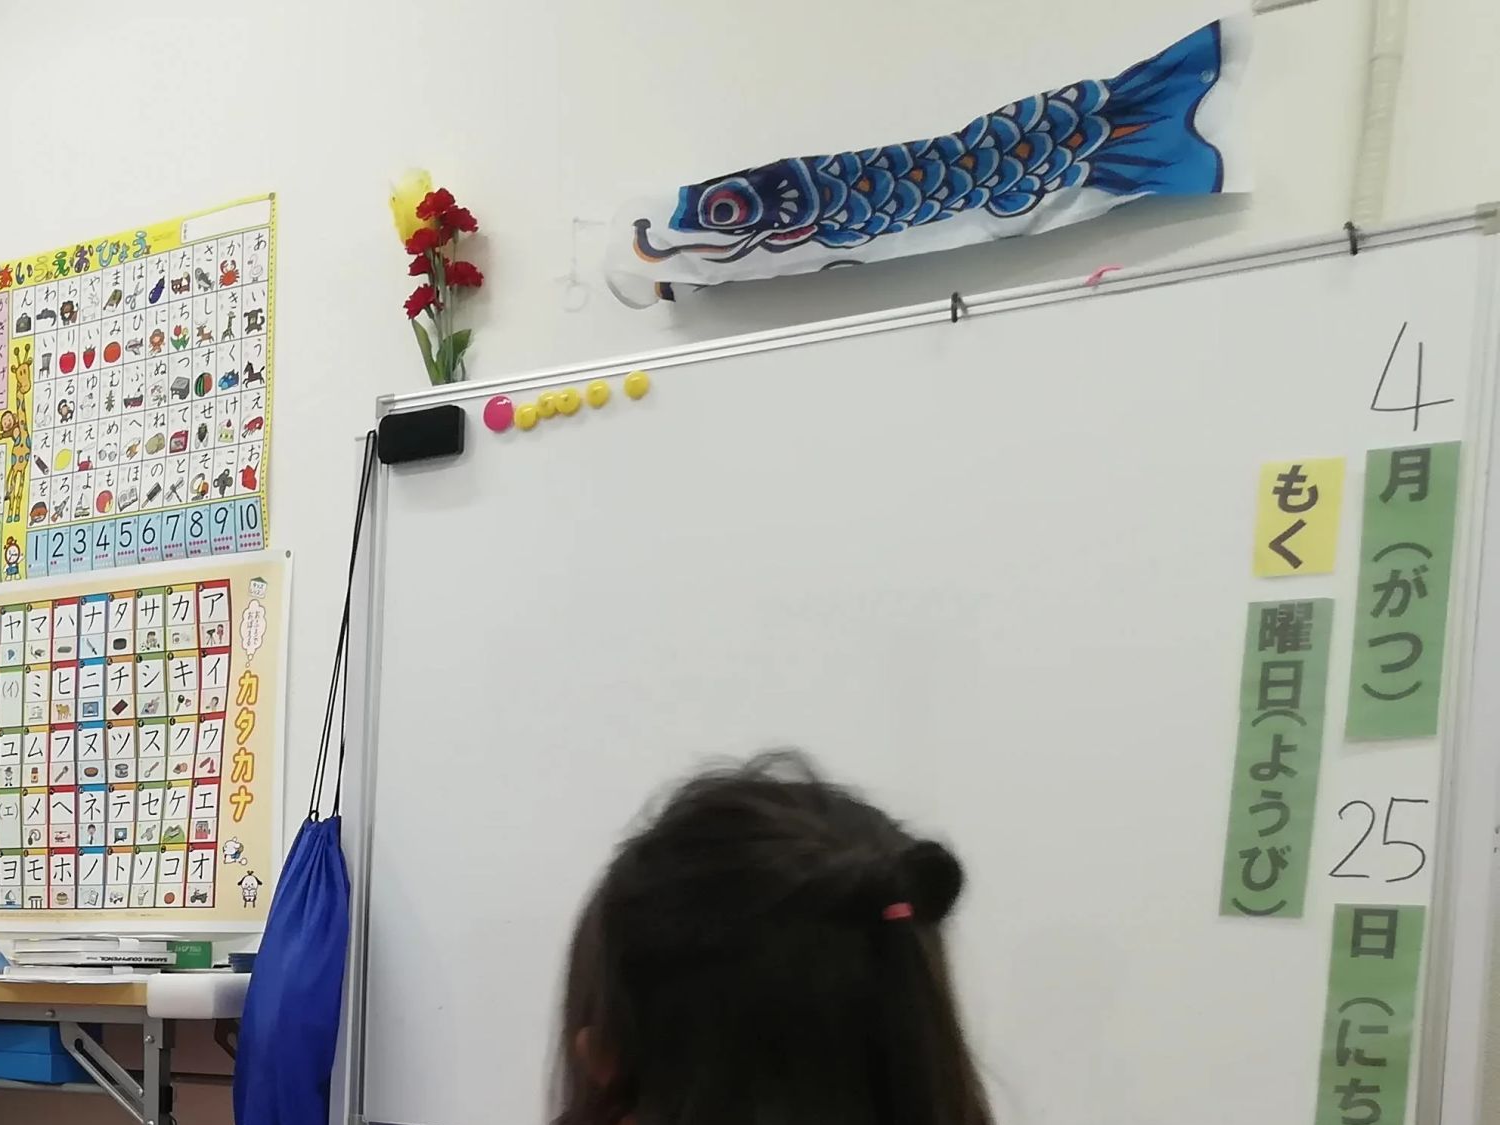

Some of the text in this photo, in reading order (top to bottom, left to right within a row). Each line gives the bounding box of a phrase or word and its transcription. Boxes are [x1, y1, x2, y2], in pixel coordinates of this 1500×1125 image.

[21, 290, 32, 308] ん
[154, 360, 167, 376] ぬ
[155, 257, 167, 274] な
[155, 309, 166, 325] に
[176, 251, 190, 474] た ち つ て と
[199, 245, 215, 469] さ し す せ そ
[225, 240, 241, 465] か き く け こ
[248, 233, 267, 462] あ い う え お
[39, 287, 56, 497] わ い う え を
[59, 281, 78, 493] ら り る れ ろ
[82, 276, 100, 490] や い ゆ え よ
[106, 270, 121, 487] ま み む め も
[127, 263, 144, 483] は ひ ふ へ ほ
[150, 463, 164, 477] の
[153, 412, 166, 428] ね
[1371, 322, 1454, 431] 4
[35, 503, 258, 561] 1 2 3 4 5 6 7 8 9 10
[1269, 464, 1319, 569] もく
[4, 615, 21, 640] ヤ
[1, 742, 18, 758] ユ
[27, 616, 47, 881] マ ミ ム メ モ
[52, 616, 75, 882] ハ ヒ フ ヘ ホ
[82, 606, 102, 880] ナ ニ ヌ ネ ノ
[110, 602, 130, 881] タ チ ツ テ ト
[139, 598, 160, 879] サ シ ス セ ソ
[164, 595, 193, 876] カ キ ク ケ コ
[192, 592, 224, 878] ア イ ウ エ オ
[229, 670, 259, 823] カタカナ
[1329, 796, 1429, 883] 25
[3, 861, 17, 880] ヨ
